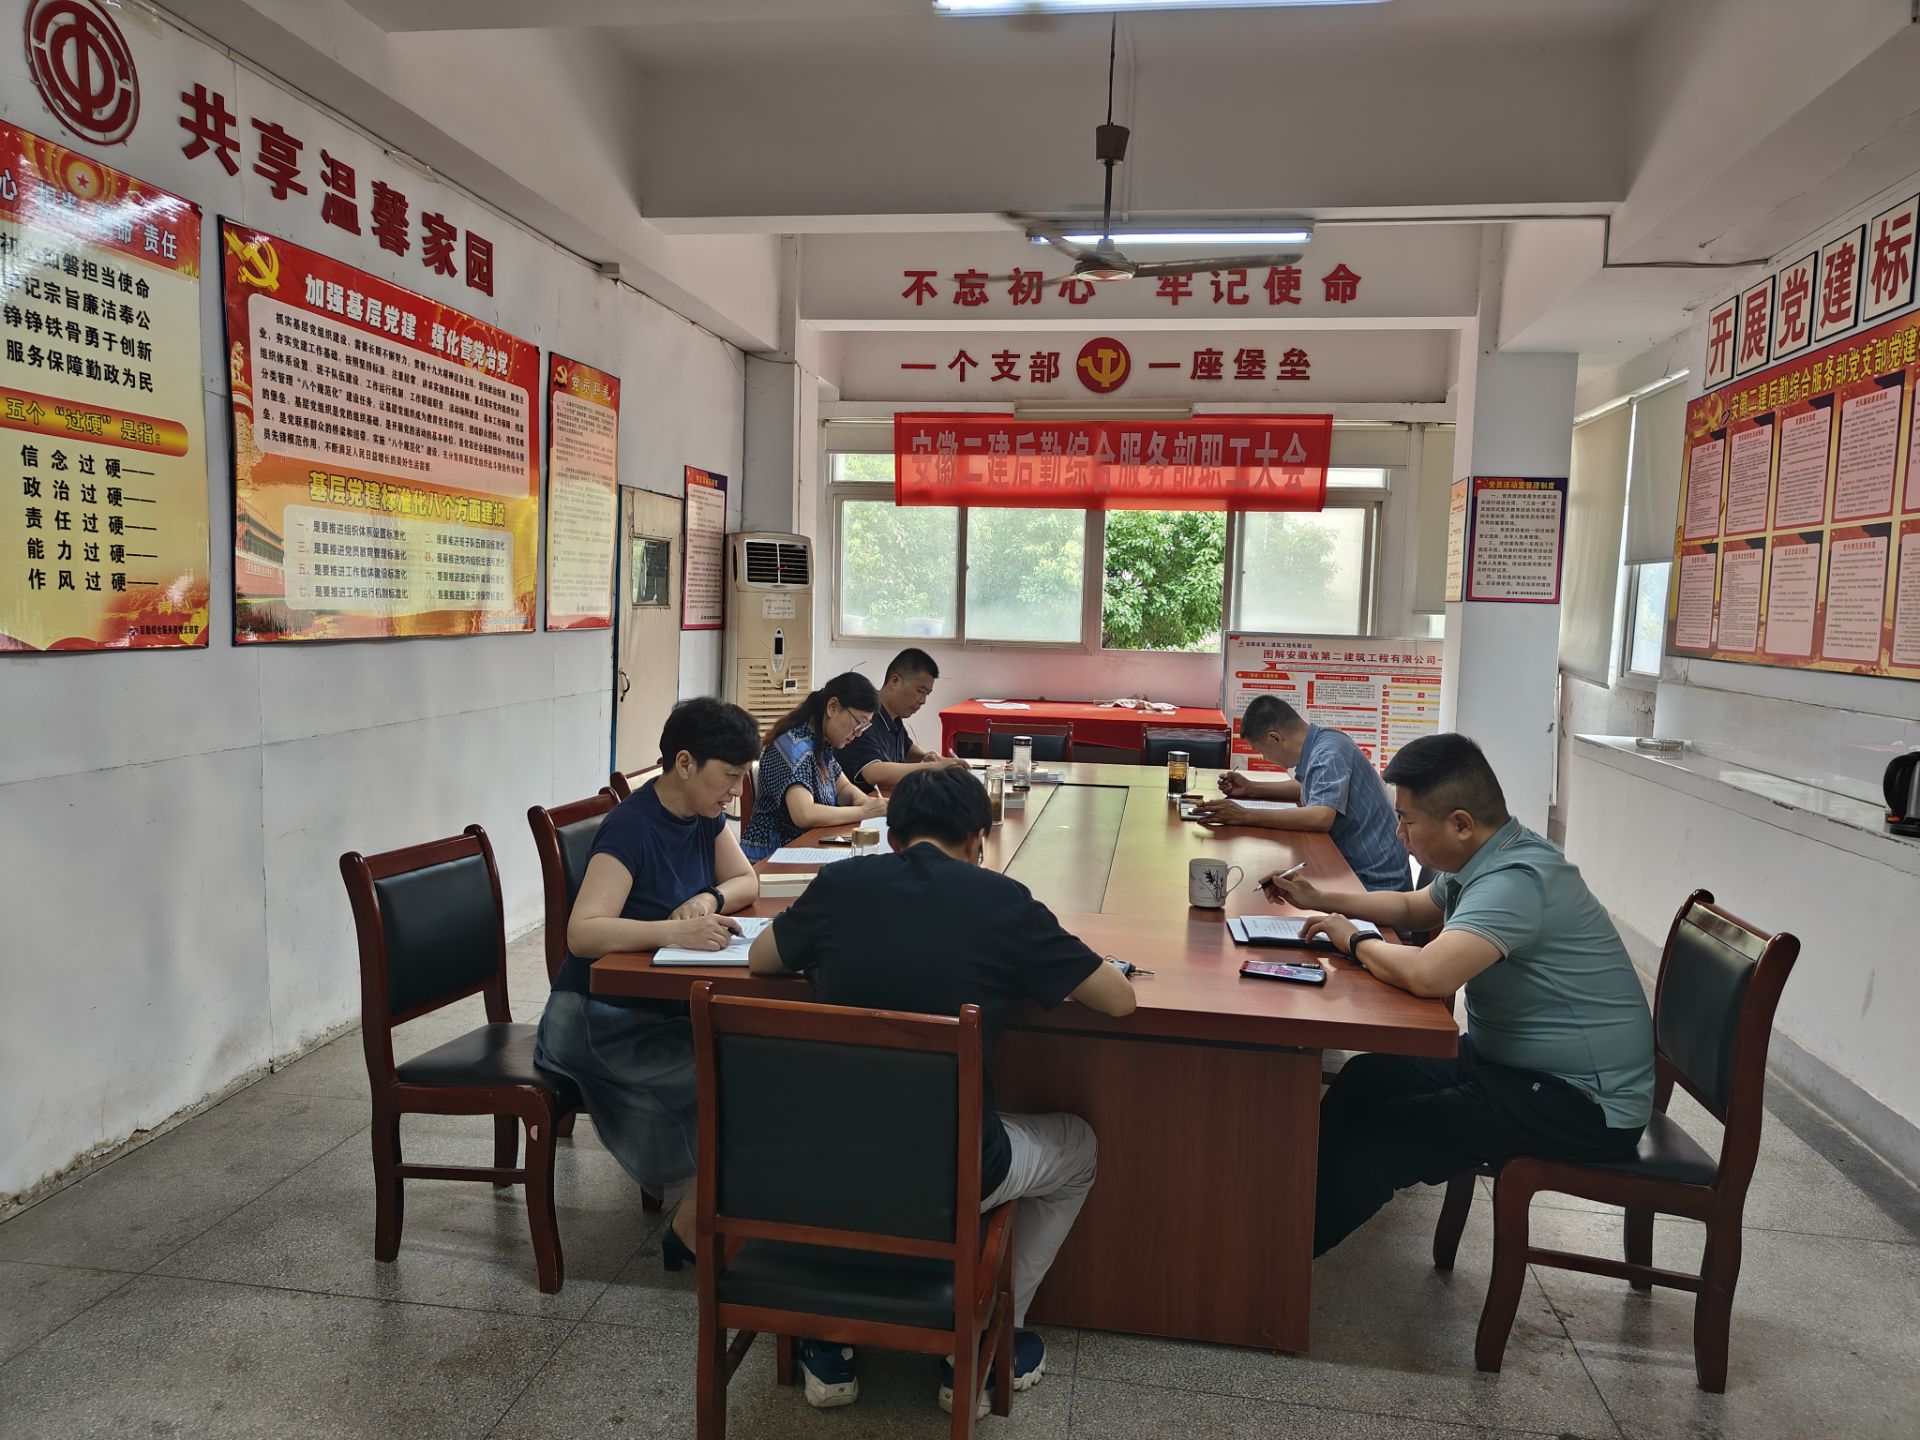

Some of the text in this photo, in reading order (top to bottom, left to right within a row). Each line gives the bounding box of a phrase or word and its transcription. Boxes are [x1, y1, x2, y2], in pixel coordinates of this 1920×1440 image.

[179, 82, 494, 297] 共享温馨家园
[144, 223, 177, 260] 责任
[901, 263, 1362, 307] 不忘初心 牢记使命
[1708, 211, 1913, 377] 开展党建标
[3, 304, 153, 362] 铮铮铁骨勇于创新
[304, 273, 509, 377] 加强基层党建 强化管党治党
[6, 338, 154, 393] 服务保障勤政为民
[900, 347, 1313, 383] 一个支部 一座堡垒
[1731, 324, 1920, 421] 安徽二建后勤综合服务部党支部党建
[910, 428, 1309, 494] 安徽二建后勤综合服务部职工大会
[308, 470, 506, 527] 基层党建标准化八个方面建设
